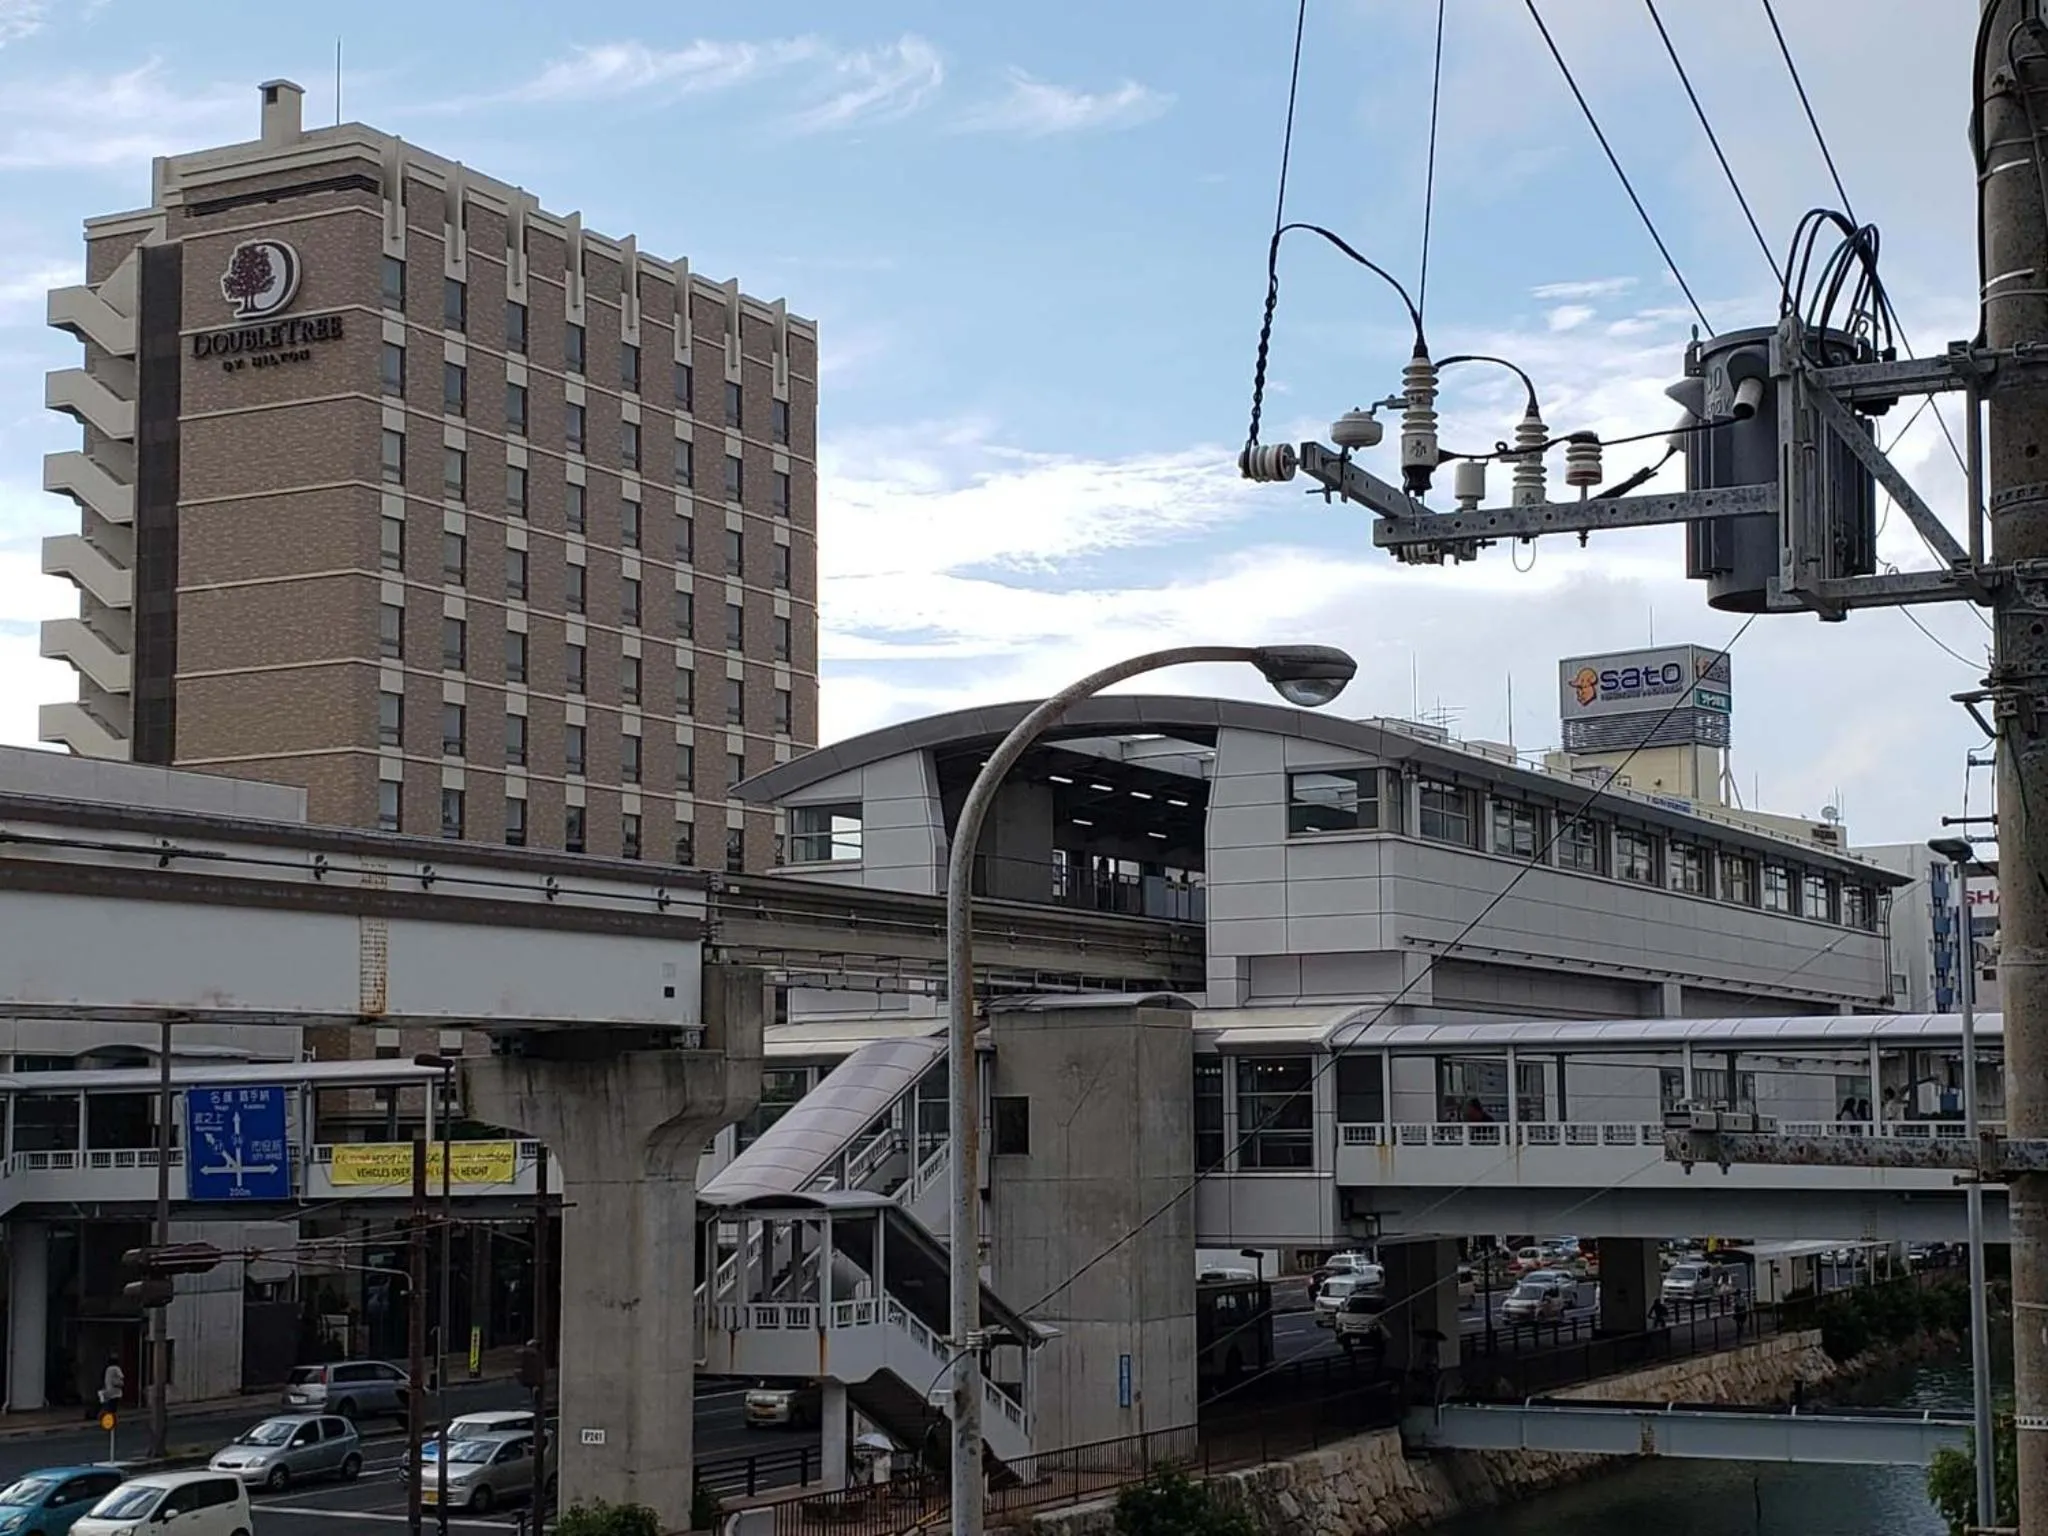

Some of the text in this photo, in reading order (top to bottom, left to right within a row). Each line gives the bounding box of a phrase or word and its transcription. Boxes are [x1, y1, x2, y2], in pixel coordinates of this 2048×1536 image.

[222, 349, 311, 373] BY HILTON
[1600, 663, 1682, 691] sato
[356, 1167, 390, 1178] VEHICLES
[391, 1166, 411, 1177] OVER
[461, 1165, 488, 1176] HEIGHT
